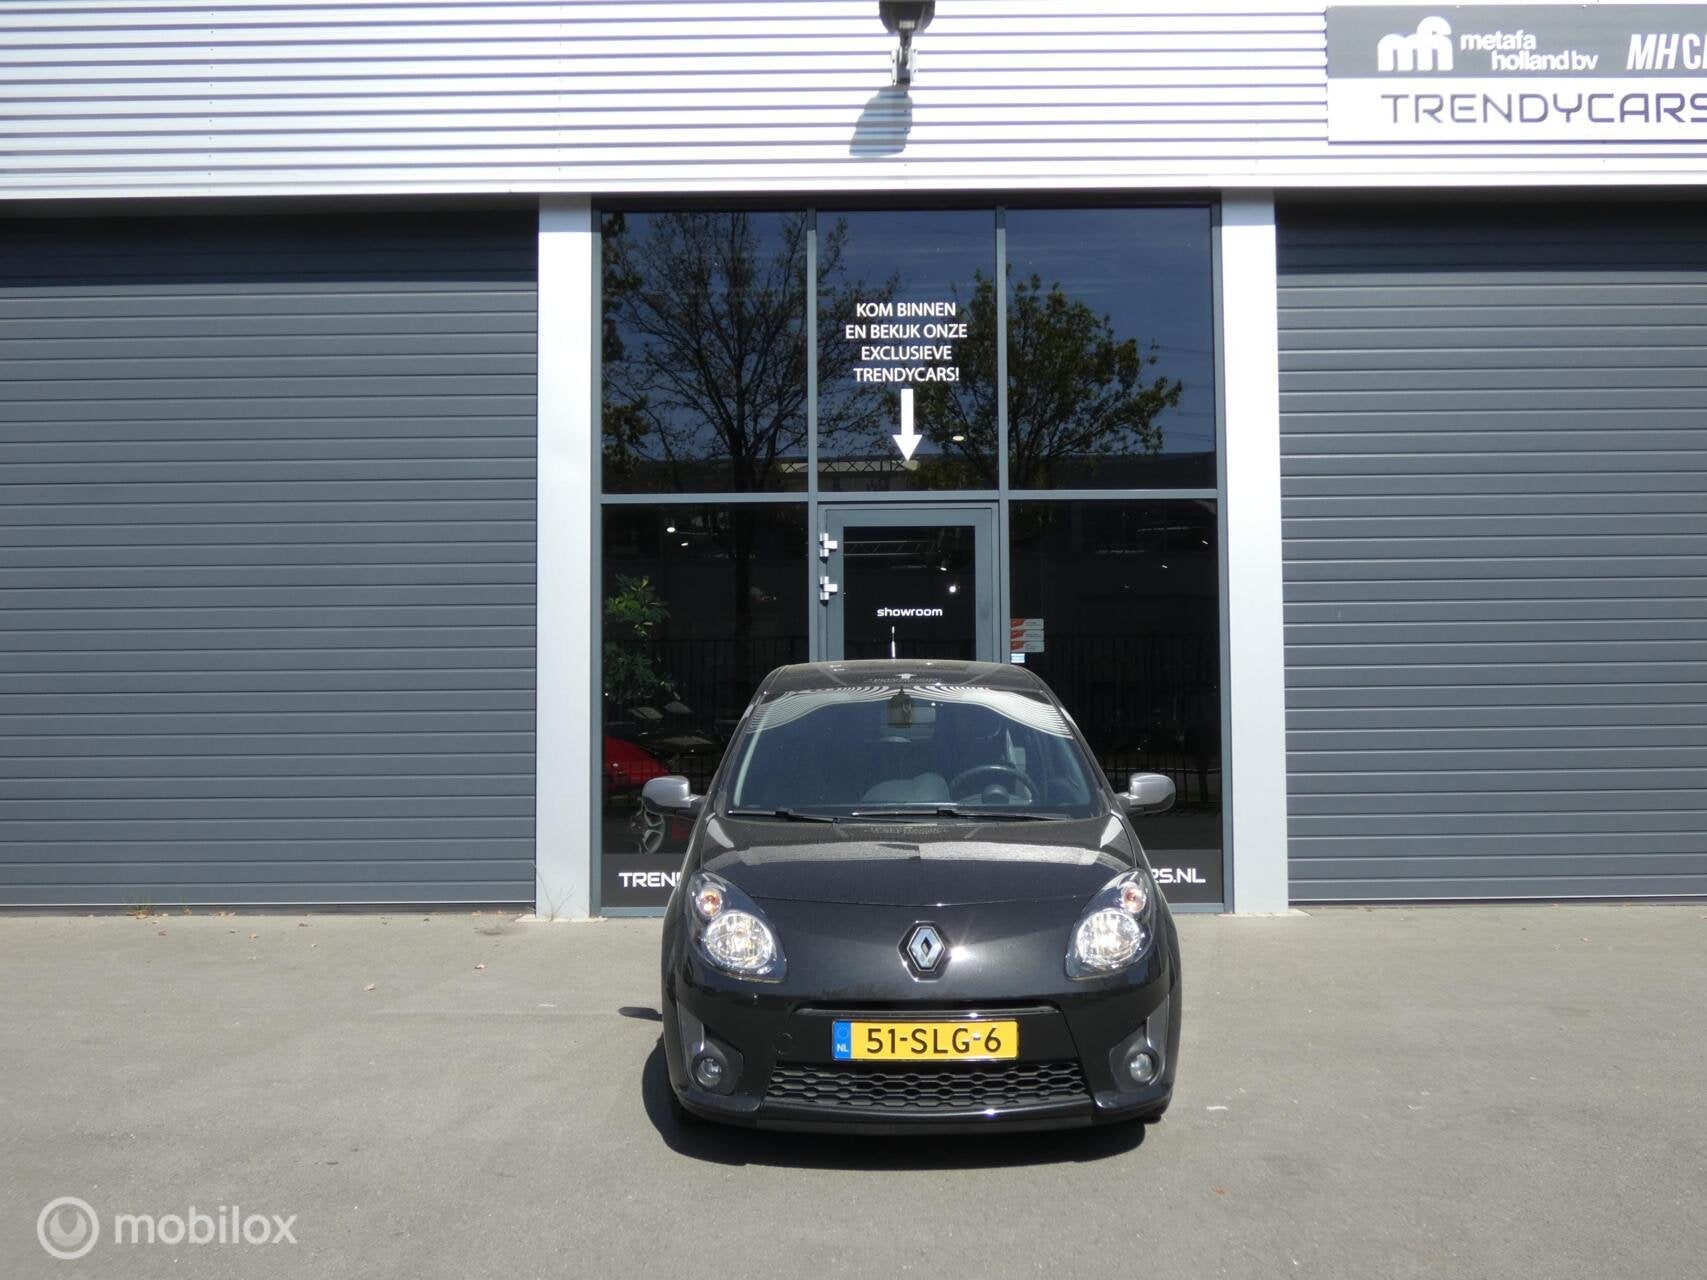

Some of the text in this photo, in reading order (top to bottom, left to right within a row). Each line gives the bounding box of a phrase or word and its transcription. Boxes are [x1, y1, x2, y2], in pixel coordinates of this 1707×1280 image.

[1460, 30, 1537, 51] metafa
[1626, 33, 1707, 70] MHC
[856, 302, 956, 317] KOM BINNEN
[845, 323, 968, 339] EN BEKIJK ONZE
[861, 345, 952, 361] EXCLUSIEVE
[853, 367, 960, 382] TRENDYCARS!
[877, 607, 943, 617] showroom
[837, 1043, 849, 1053] NL
[866, 1027, 1002, 1055] 51-SLG-6
